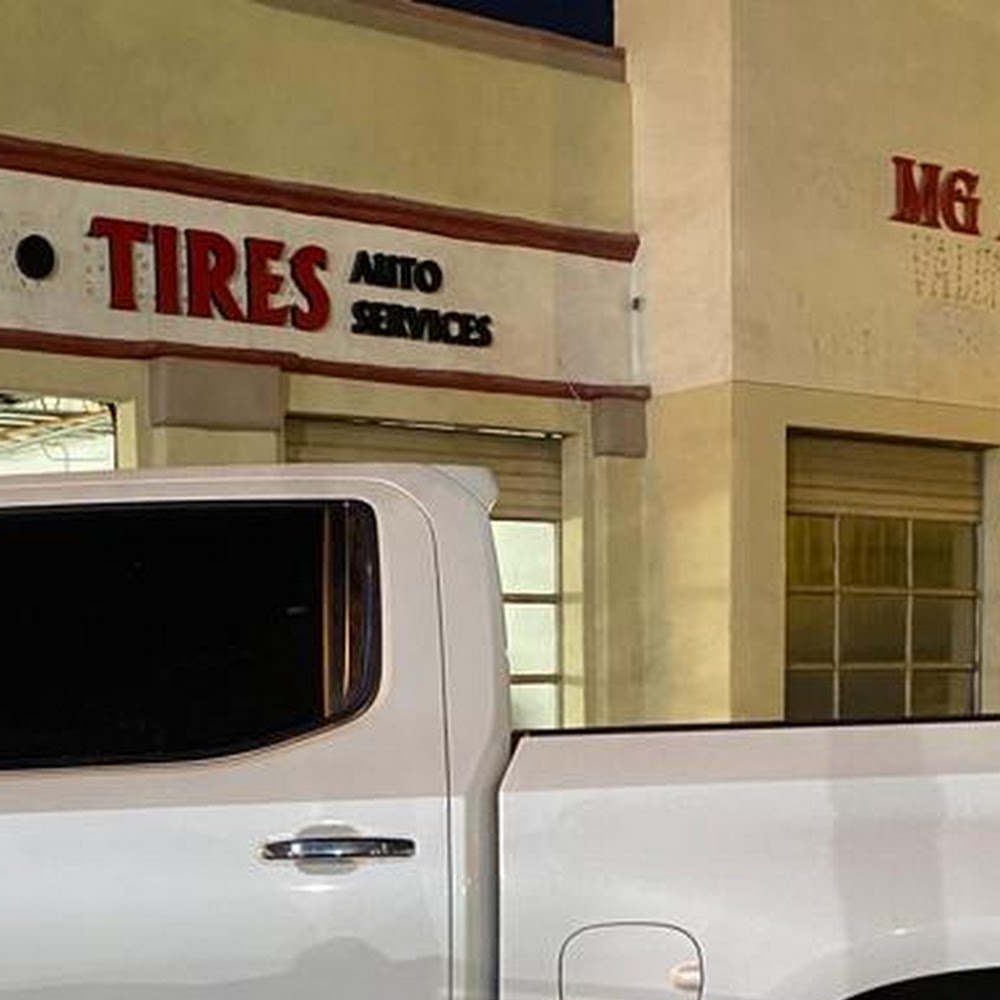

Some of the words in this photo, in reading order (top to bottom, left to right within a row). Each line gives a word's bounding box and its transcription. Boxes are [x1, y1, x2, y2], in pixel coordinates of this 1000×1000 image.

[889, 155, 983, 236] MG
[87, 216, 331, 332] TIRES
[349, 250, 443, 293] AUTO
[351, 300, 493, 347] SERVICES
